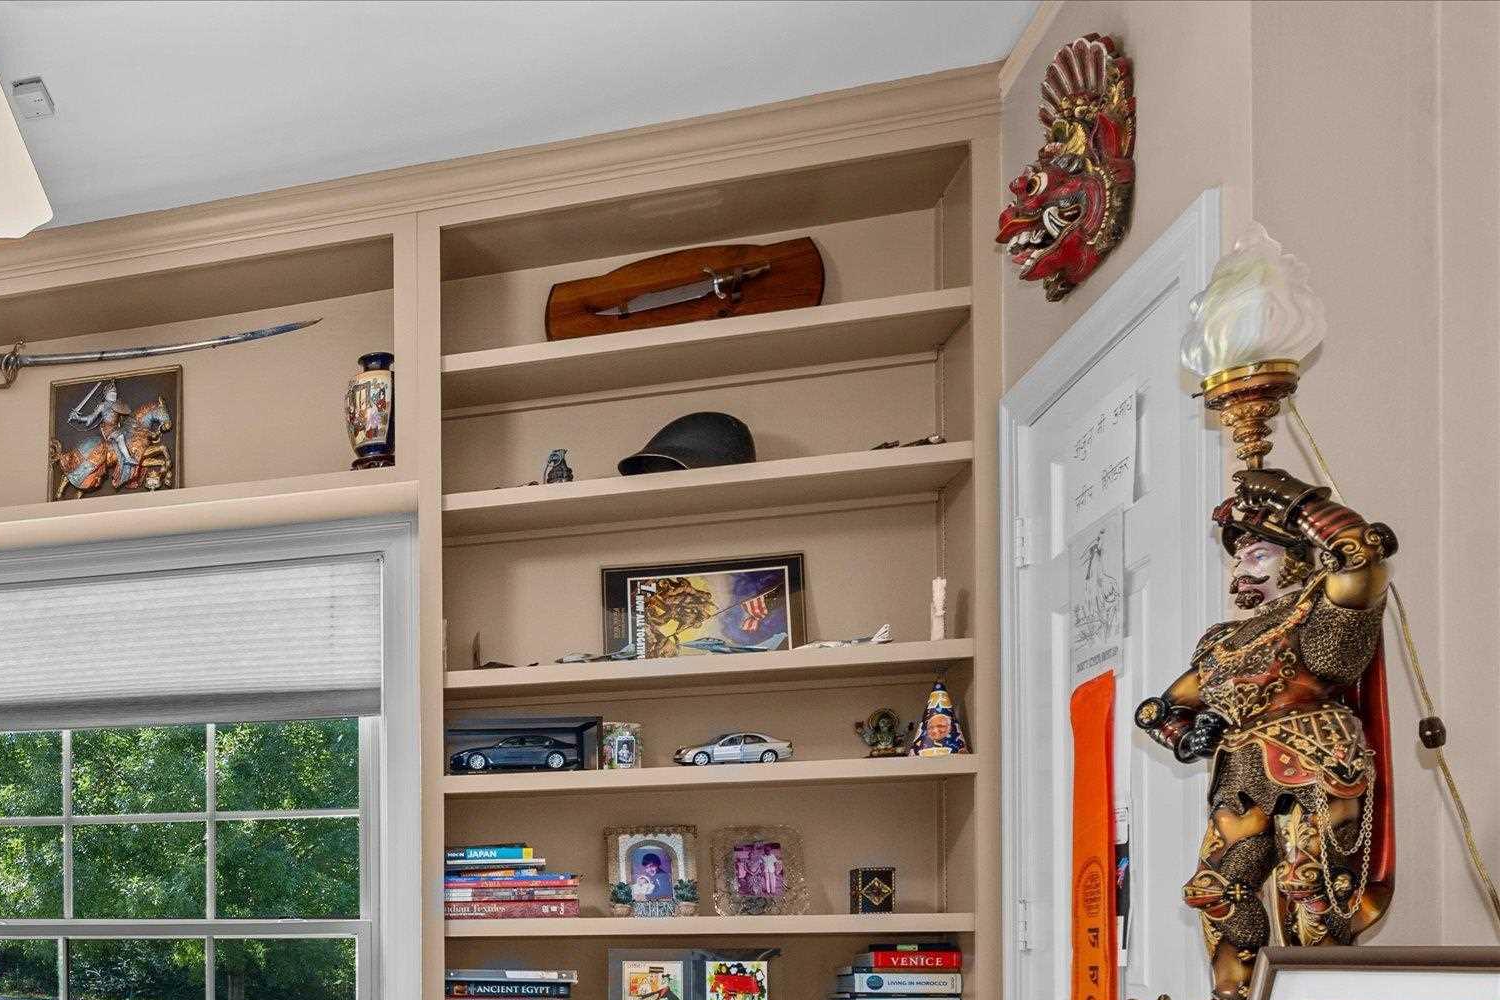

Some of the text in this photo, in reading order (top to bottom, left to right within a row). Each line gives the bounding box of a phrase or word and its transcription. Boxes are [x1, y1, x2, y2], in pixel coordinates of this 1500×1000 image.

[466, 850, 498, 858] JAPAN
[471, 903, 506, 913] Textiles
[891, 956, 944, 967] VENICE
[476, 986, 551, 995] ANCIENT EGYPT
